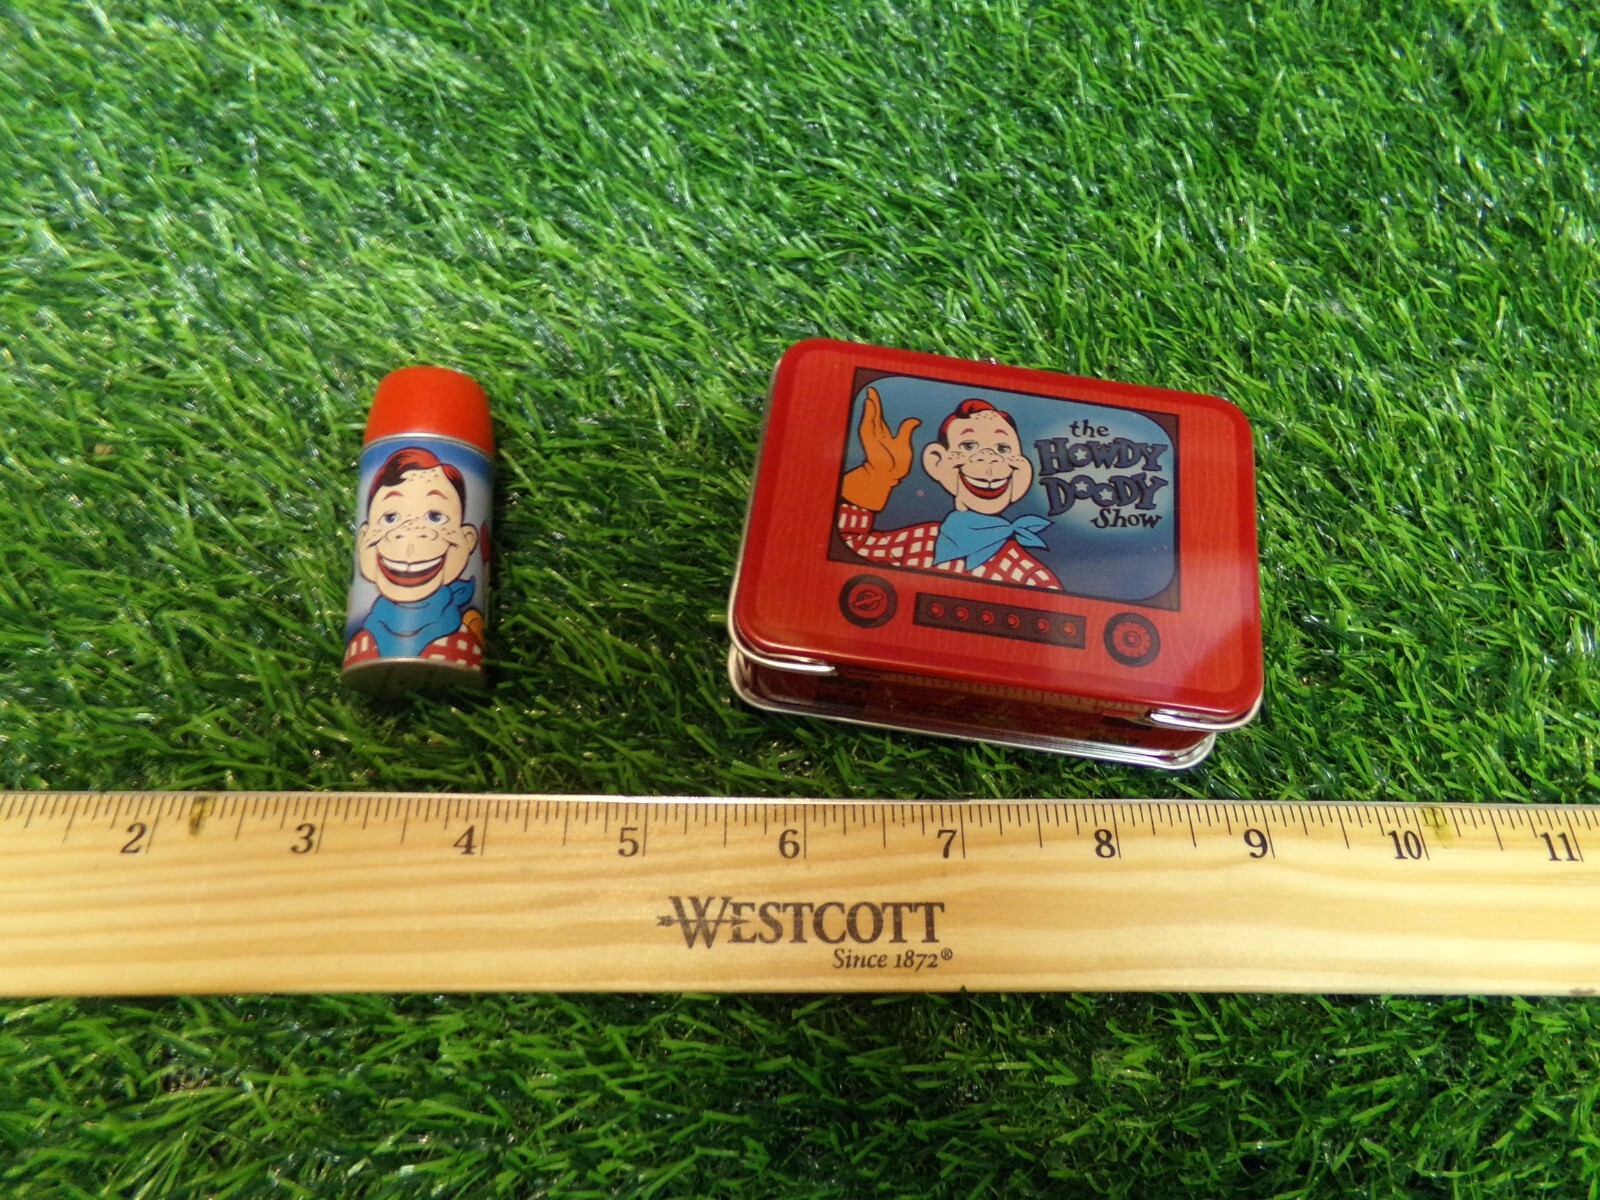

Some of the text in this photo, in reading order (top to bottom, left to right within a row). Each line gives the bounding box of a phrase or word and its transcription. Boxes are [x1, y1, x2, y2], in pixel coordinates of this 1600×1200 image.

[1069, 419, 1109, 437] the
[1034, 437, 1168, 476] HOWDY
[1039, 472, 1168, 516] DOODY
[1090, 507, 1162, 529] Show
[121, 822, 1579, 861] 2 3 4 5 6 7 8 9 10 11
[657, 895, 945, 949] WESTCOTT
[832, 948, 888, 969] Since
